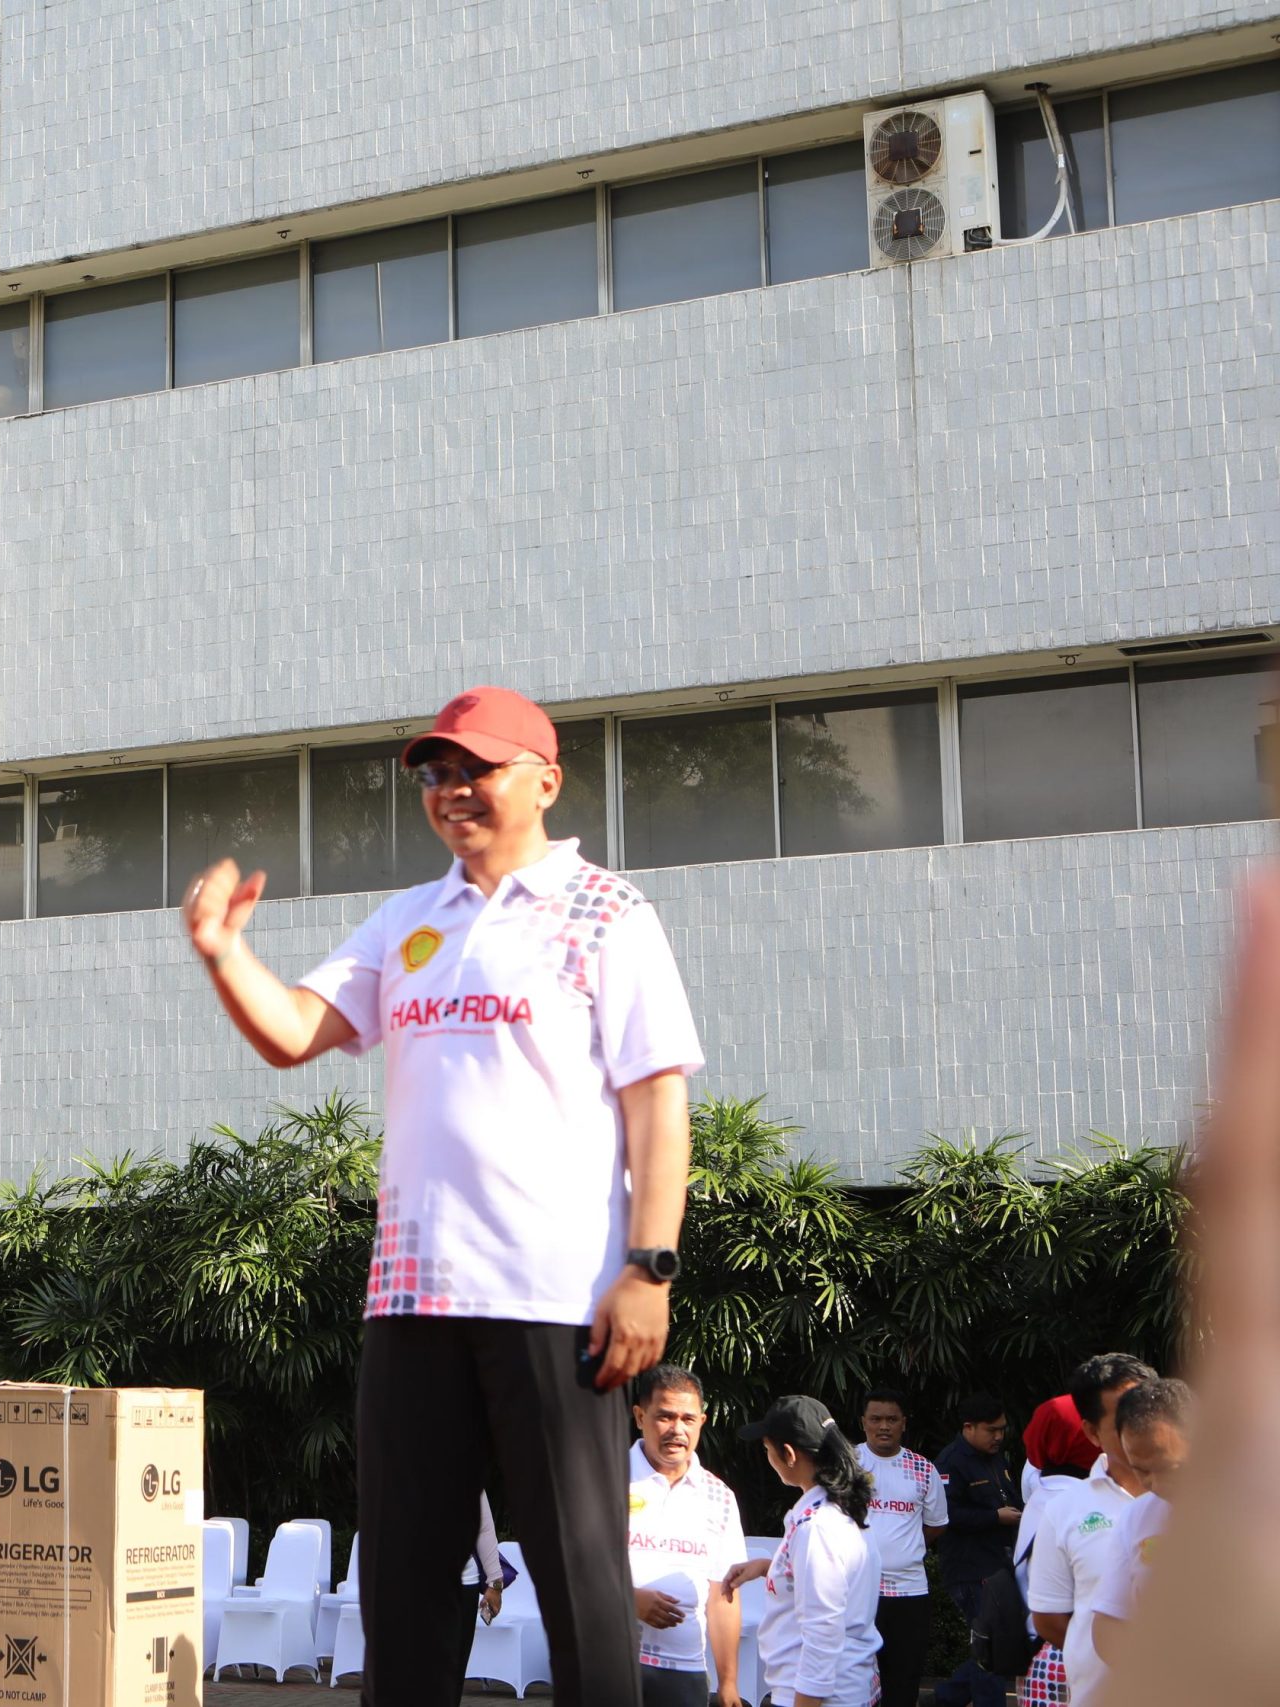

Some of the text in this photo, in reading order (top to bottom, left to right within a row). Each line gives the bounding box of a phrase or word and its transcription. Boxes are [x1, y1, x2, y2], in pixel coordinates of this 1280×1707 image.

[23, 1466, 60, 1493] LG
[162, 1470, 181, 1495] LG
[22, 1499, 43, 1508] Life's
[126, 1544, 195, 1565] REFRIGERATOR
[5, 1690, 20, 1700] NOT
[21, 1691, 46, 1703] CLAMP
